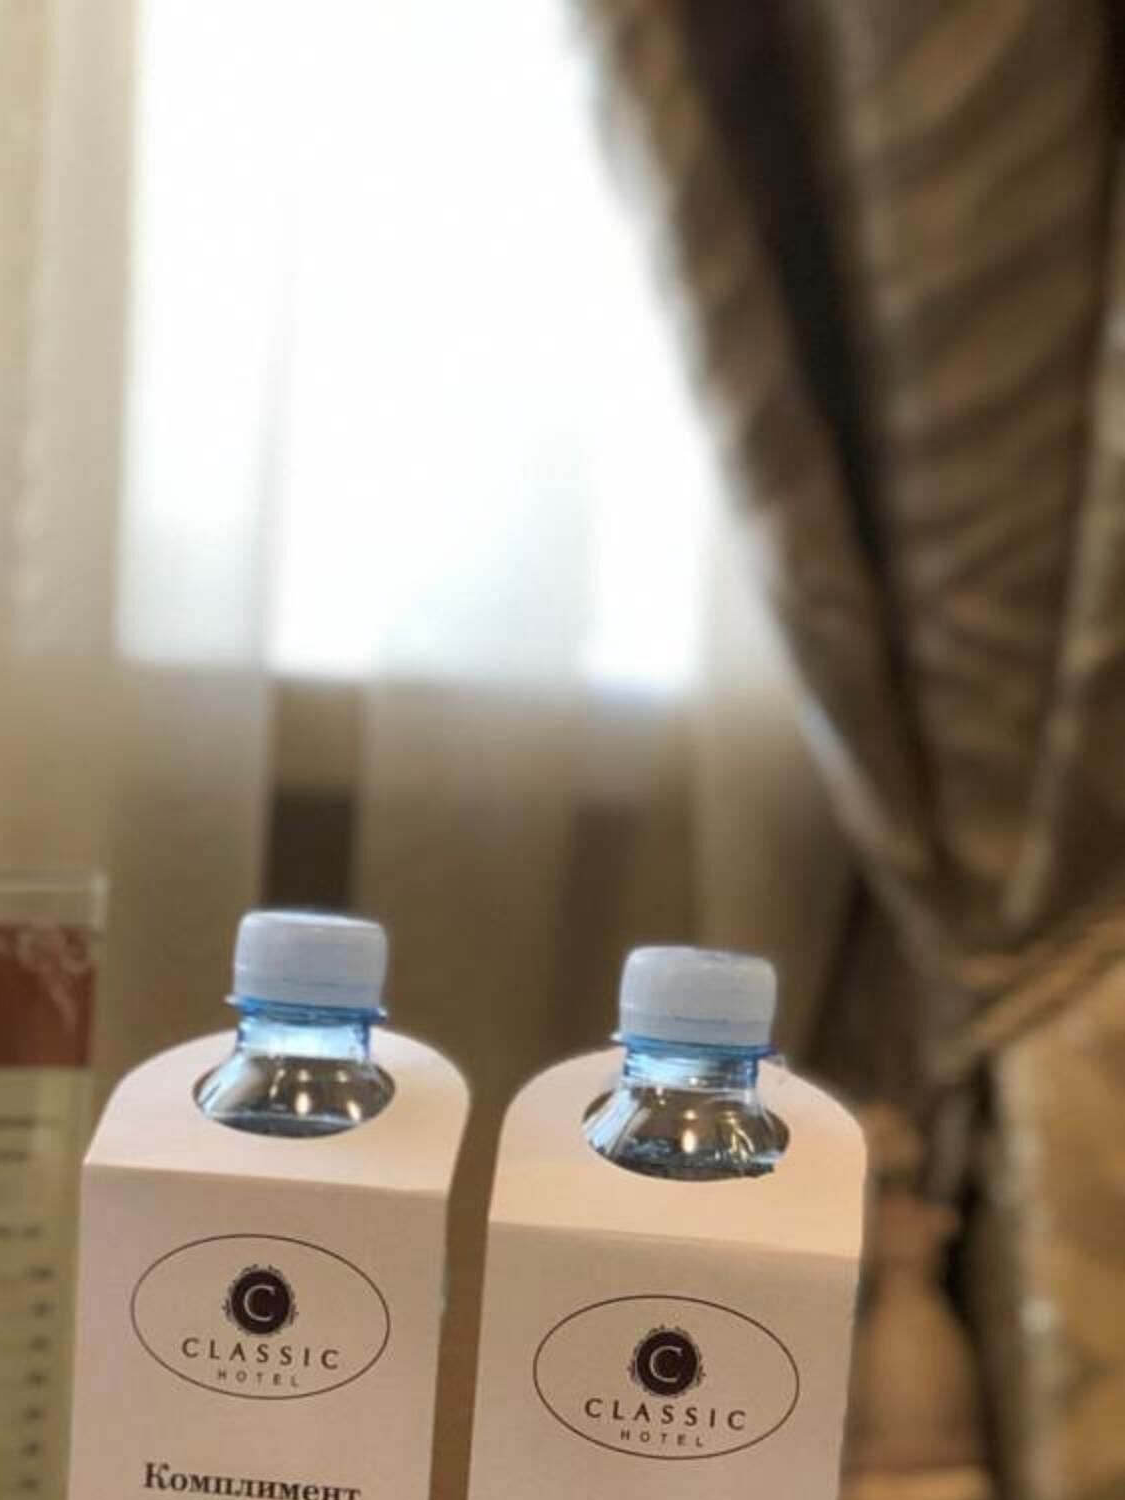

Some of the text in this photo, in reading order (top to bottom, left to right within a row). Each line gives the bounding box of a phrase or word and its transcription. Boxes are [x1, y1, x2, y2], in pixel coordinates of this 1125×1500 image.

[180, 1336, 340, 1371] CLASSIC
[216, 1369, 300, 1388] HOTEL
[583, 1397, 747, 1432] CLASSIC
[620, 1429, 705, 1448] HOTEL
